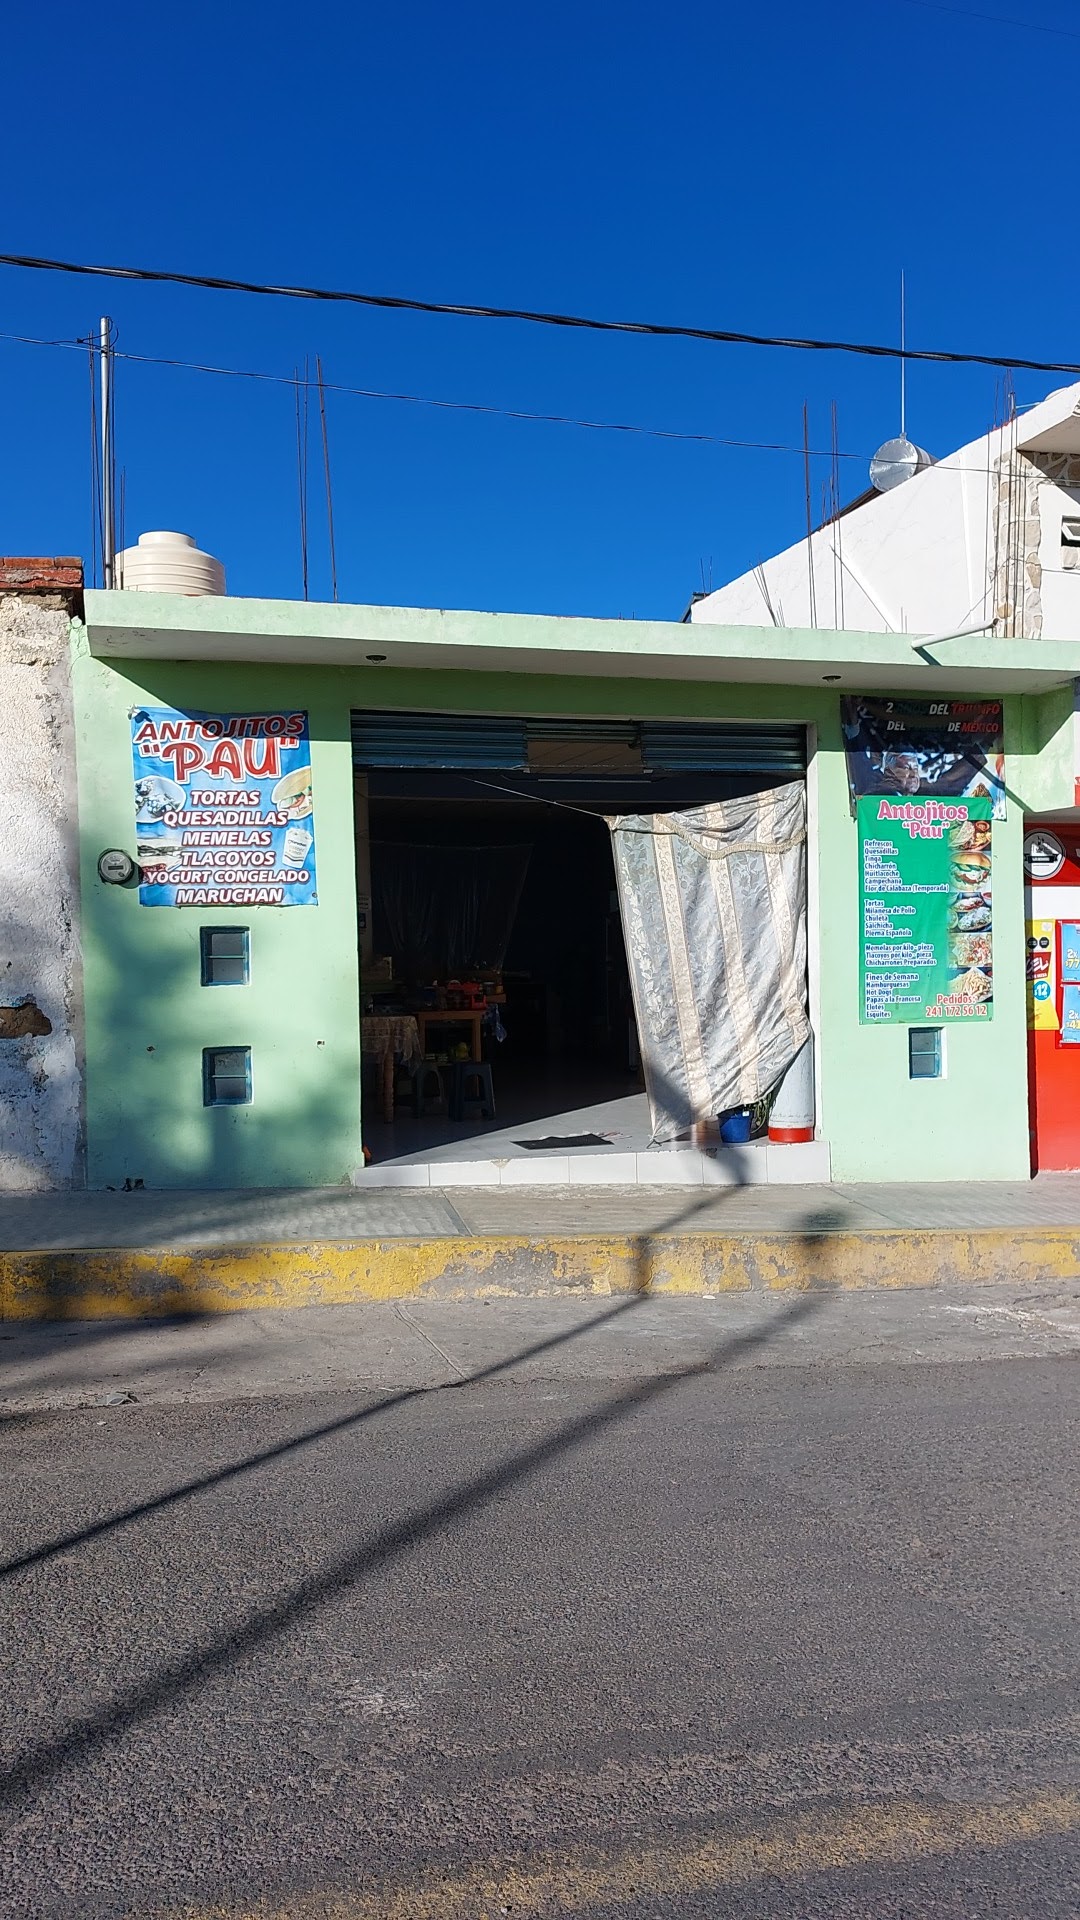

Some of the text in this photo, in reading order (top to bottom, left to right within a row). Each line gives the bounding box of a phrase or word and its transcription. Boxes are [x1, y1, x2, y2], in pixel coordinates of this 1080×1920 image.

[886, 702, 893, 713] 2
[929, 704, 949, 715] DEL
[134, 714, 305, 742] ANTOJITOS
[886, 720, 905, 731] DEL
[948, 722, 960, 732] DE
[961, 720, 999, 733] MÉXICO
[142, 736, 297, 782] "PAU"
[191, 791, 260, 805] TORTAS
[878, 801, 967, 824] Antojitos
[163, 811, 288, 826] QUESADILLAS
[183, 831, 271, 846] MEMELAS
[181, 852, 275, 867] TLACOYOS
[864, 855, 881, 863] Tinga
[864, 862, 897, 870] Chicharrón
[147, 871, 309, 884] YOGURT CONGELADO
[864, 877, 902, 885] Campechana
[912, 884, 949, 893] (Temporada)
[176, 889, 284, 904] MARUCHAN
[865, 899, 884, 907] Tortas
[885, 929, 912, 938] Española
[892, 944, 902, 952] por
[917, 943, 934, 952] pieza
[866, 951, 890, 959] Tlacoyos
[916, 951, 932, 959] pieza
[903, 958, 936, 966] Preparados
[893, 972, 919, 980] Semana
[866, 981, 909, 989] Hamburguesas
[878, 989, 892, 997] Dogs
[937, 994, 976, 1004] Pedidos:
[866, 1011, 891, 1019] Esquites
[926, 1005, 987, 1017] 241 172 56 12
